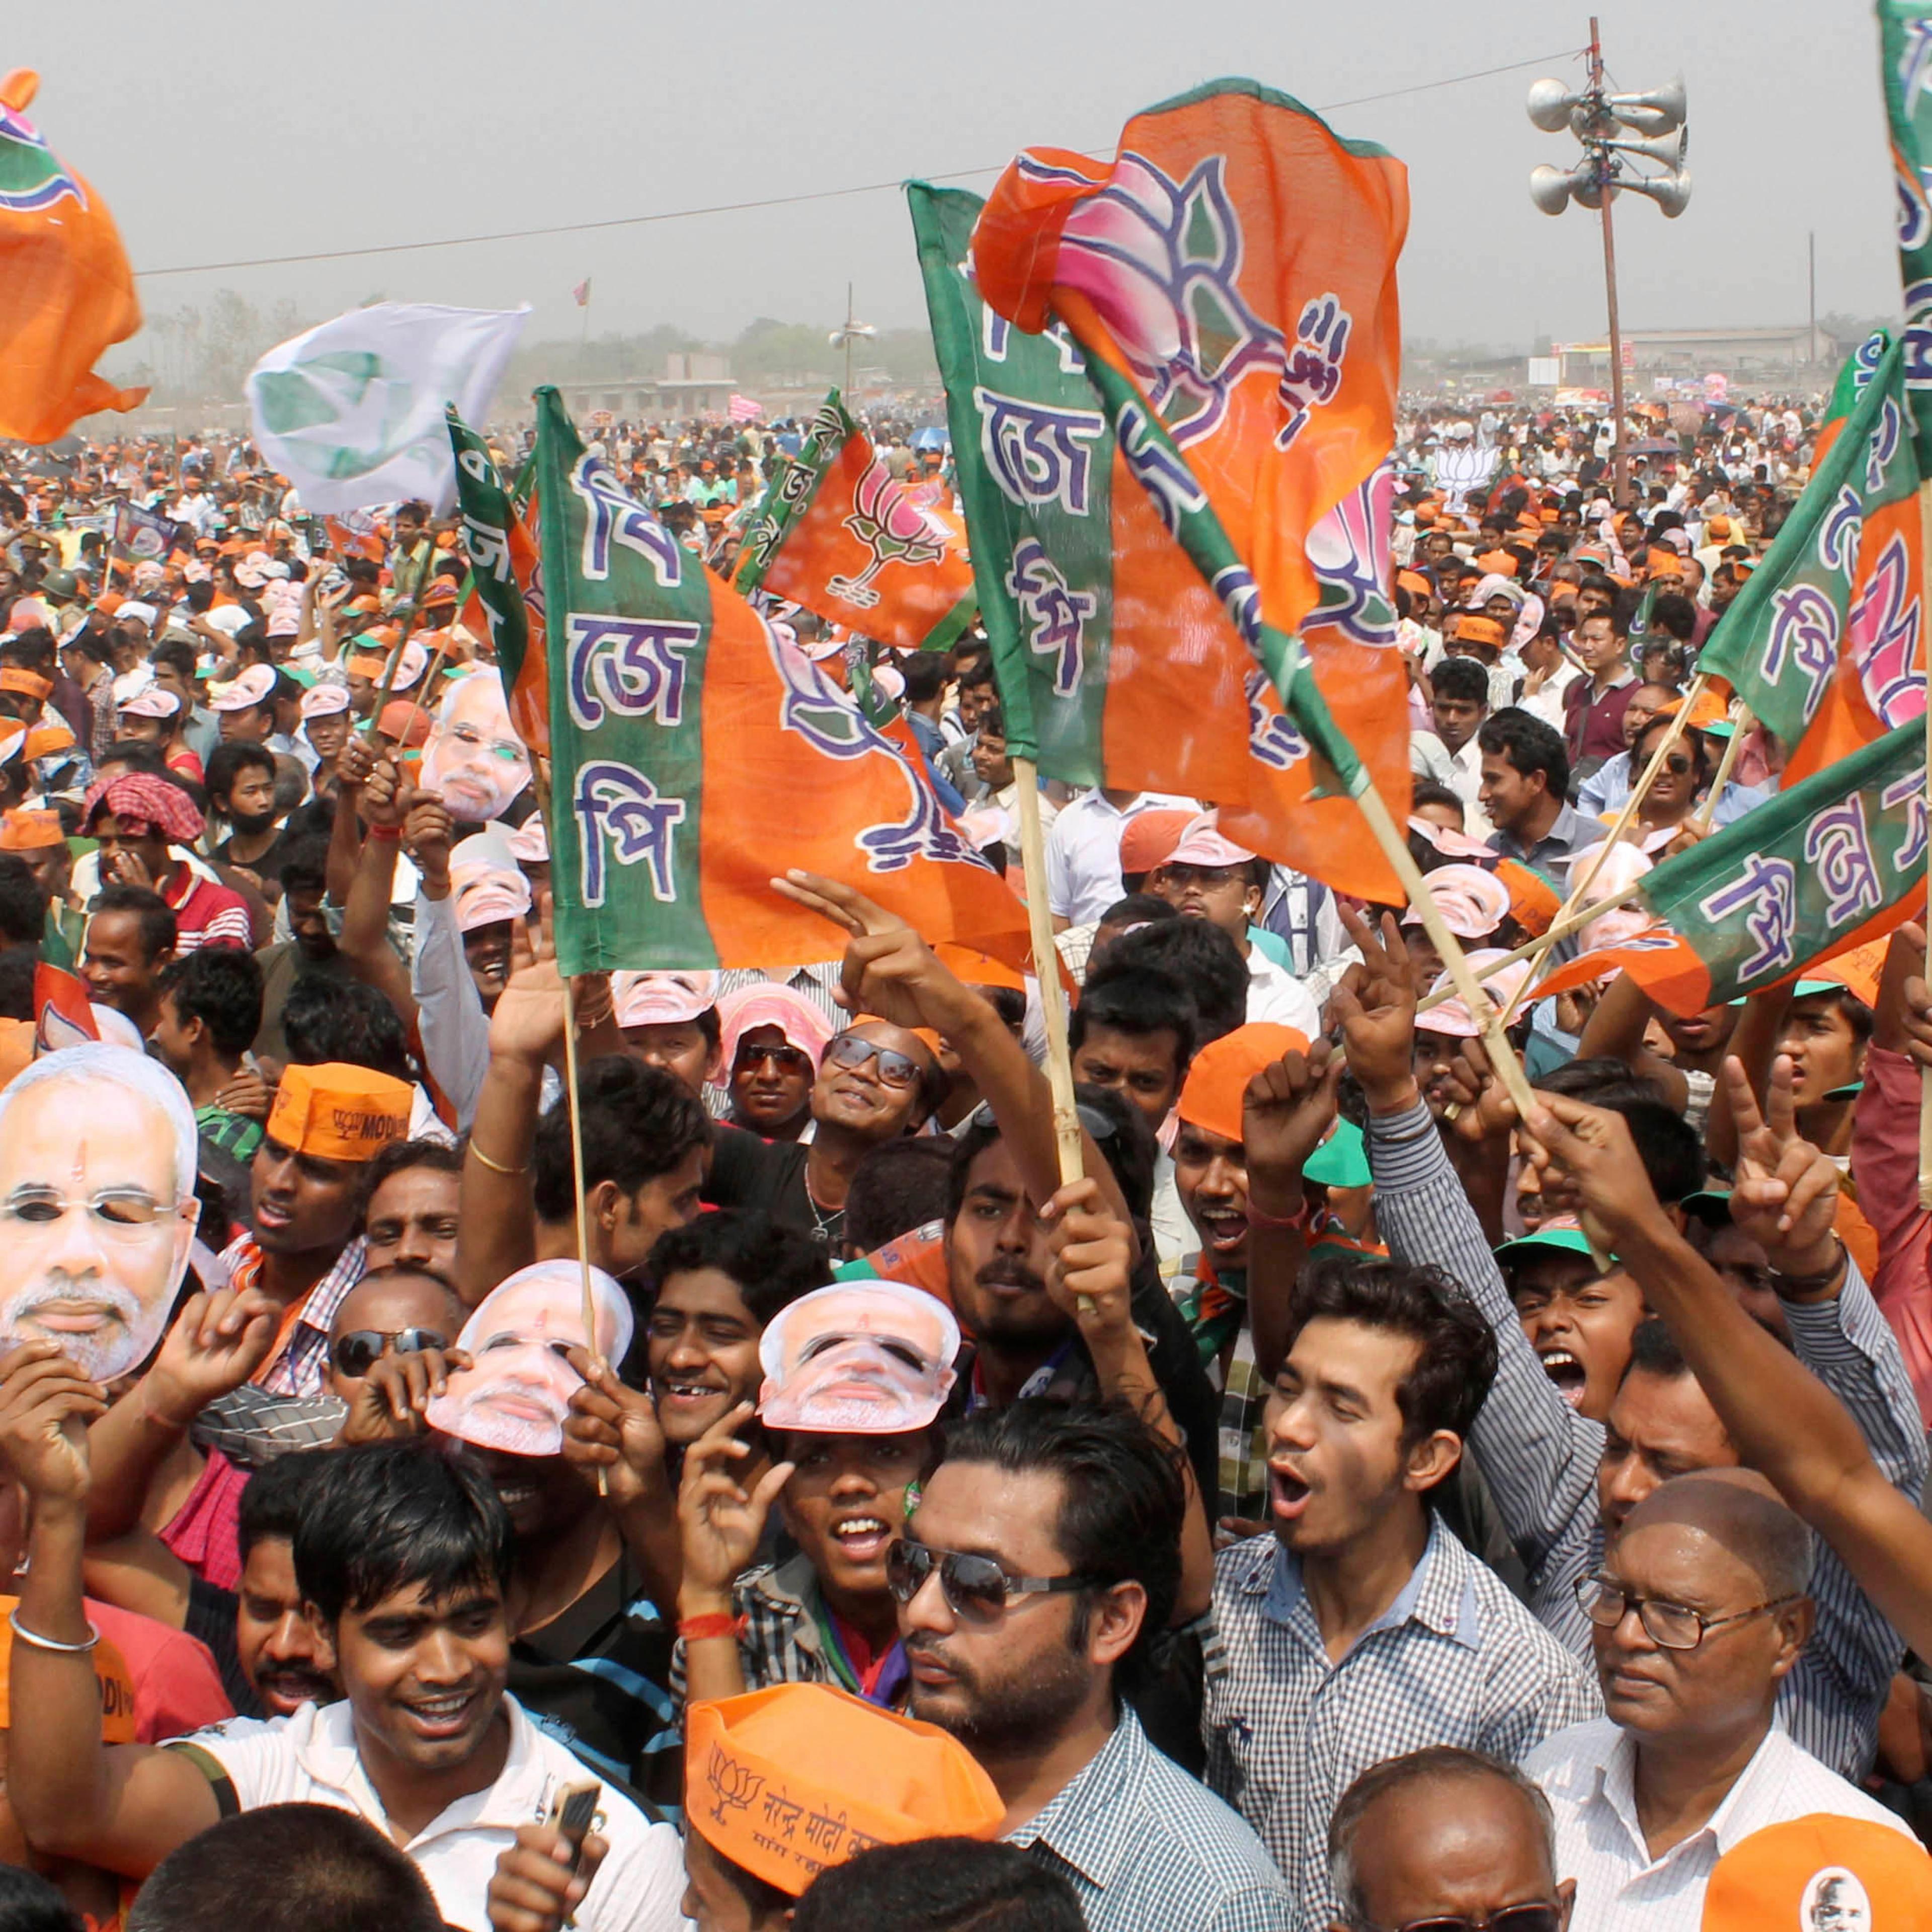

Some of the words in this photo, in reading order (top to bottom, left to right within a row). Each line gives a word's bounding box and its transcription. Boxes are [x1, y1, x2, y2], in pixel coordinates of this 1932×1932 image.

[569, 446, 681, 587] বি
[566, 612, 701, 731] জে
[1760, 583, 1838, 727] পি
[574, 760, 686, 908] পি
[1804, 791, 1883, 929] জে
[1699, 852, 1795, 984] পি
